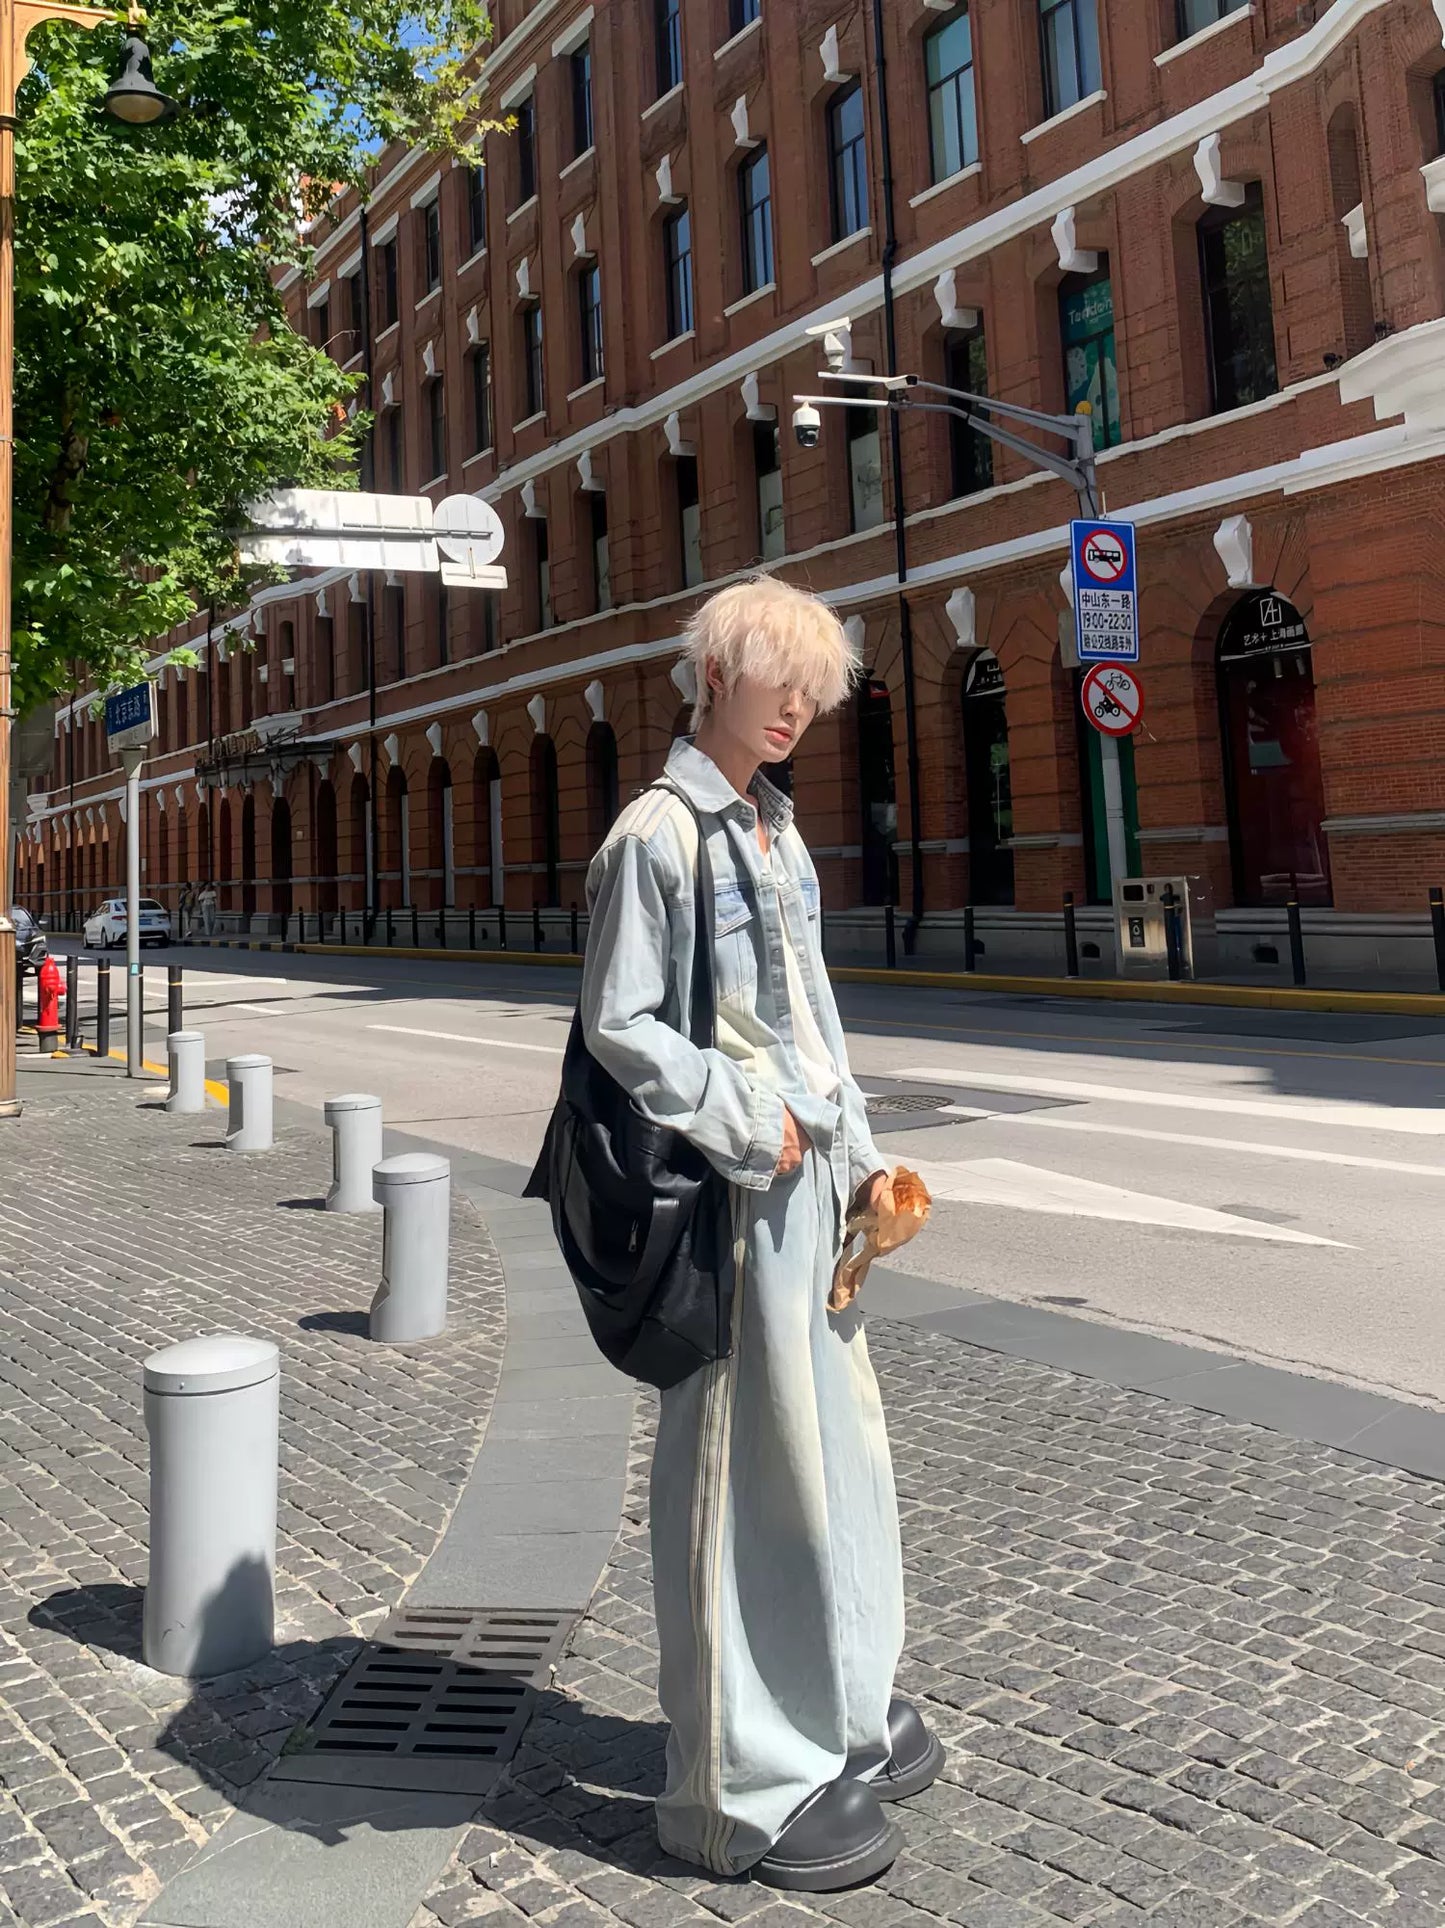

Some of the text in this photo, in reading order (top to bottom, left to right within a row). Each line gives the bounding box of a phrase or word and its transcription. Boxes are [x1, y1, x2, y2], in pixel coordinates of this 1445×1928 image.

[1082, 591, 1131, 609] 中山东一路
